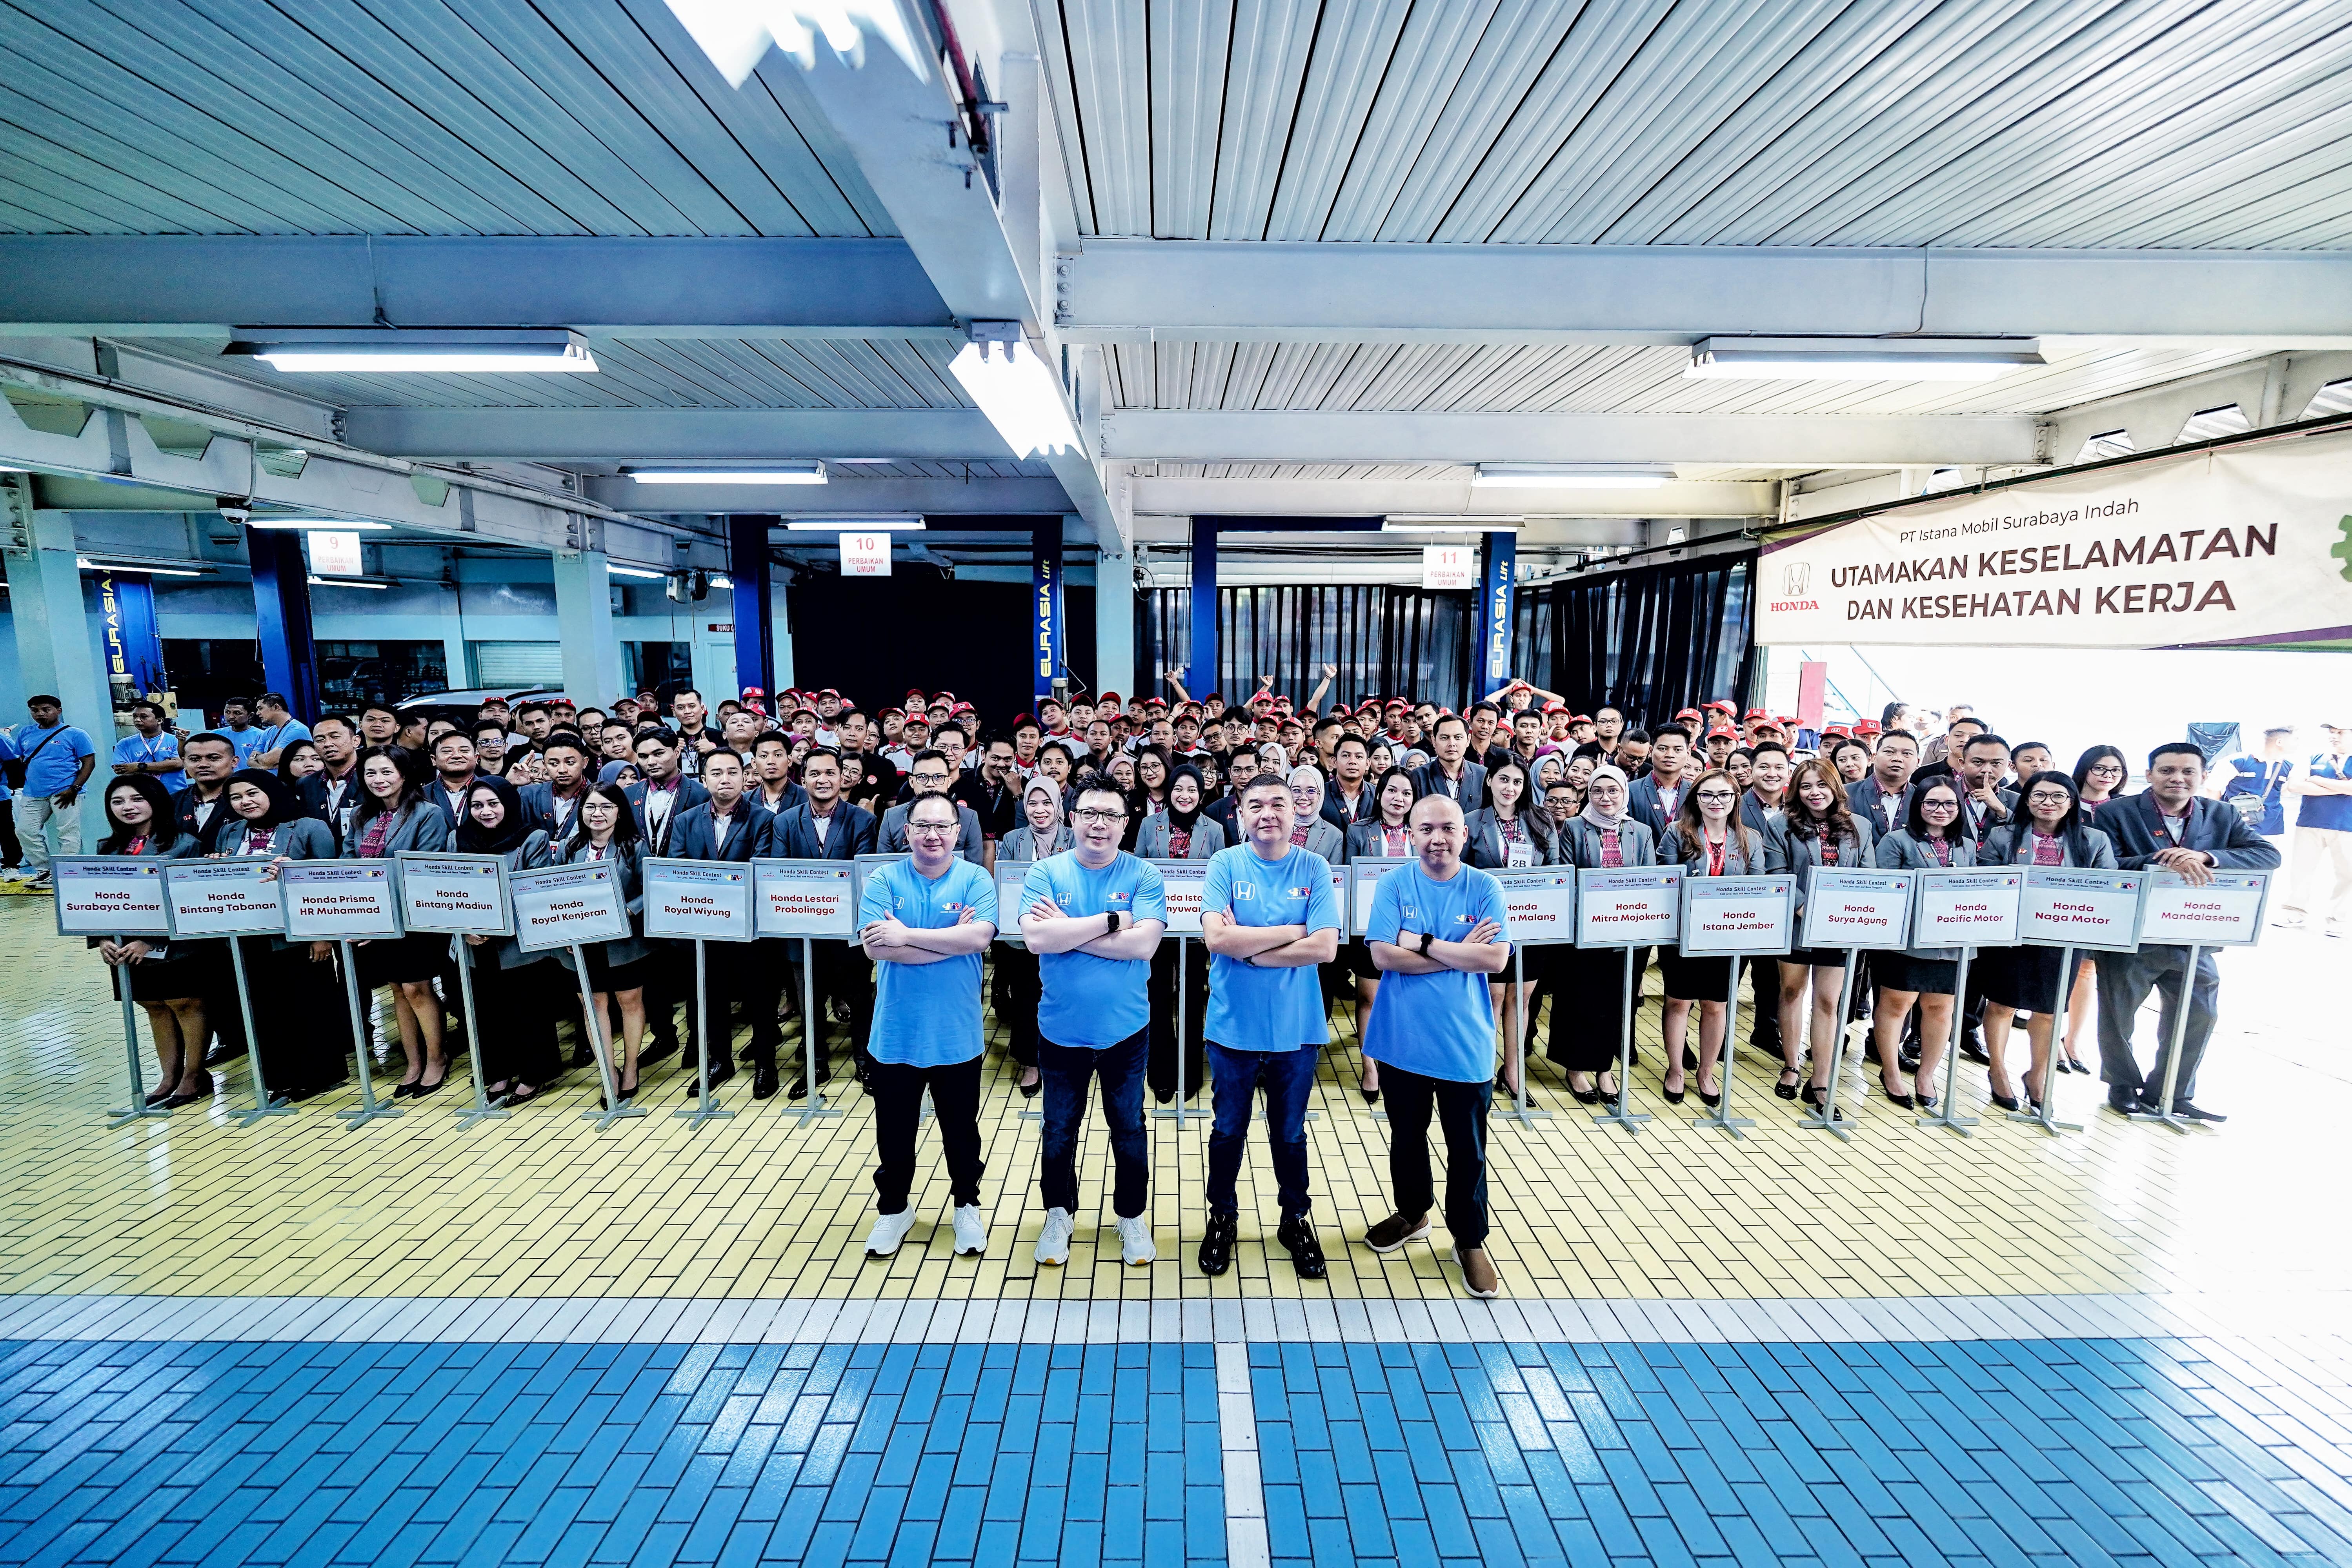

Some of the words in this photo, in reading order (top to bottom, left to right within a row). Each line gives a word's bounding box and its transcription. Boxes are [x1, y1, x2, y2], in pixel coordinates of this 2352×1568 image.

[1900, 531, 1916, 544] PT
[1919, 526, 1957, 541] Istana
[1962, 518, 1998, 536] Mobil
[2003, 509, 2078, 530] Surabaya
[2085, 498, 2139, 518] Indah
[330, 537, 338, 549] 9
[857, 538, 874, 550] 10
[1441, 552, 1456, 563] 11
[1832, 555, 1968, 587] UTAMAKAN
[1979, 523, 2278, 577] KESELAMATAN
[1771, 600, 1819, 611] HONDA
[1848, 598, 1893, 620] DAN
[1902, 588, 2080, 619] KESEHATAN
[2096, 580, 2236, 614] KERJA
[102, 578, 124, 673] EURASIA
[1039, 583, 1051, 677] EURASIA
[1492, 584, 1507, 678] EURASIA
[67, 903, 120, 911] Surabaya
[317, 906, 380, 915] Muhammad
[416, 900, 453, 910] Bintang
[550, 901, 584, 911] Honda
[775, 906, 835, 915] Probolinggo
[2054, 902, 2094, 911] Honda
[531, 915, 559, 925] Royal
[563, 910, 606, 920] Kenjeran
[665, 906, 691, 915] Royal
[694, 908, 730, 918] Wiyung
[1621, 913, 1670, 922] Mojokerto
[2161, 912, 2239, 922] Mandalasena
[1828, 915, 1855, 924] Surya
[1857, 917, 1887, 926] Agung
[2035, 912, 2068, 922] Naga
[2072, 915, 2110, 924] Motor
